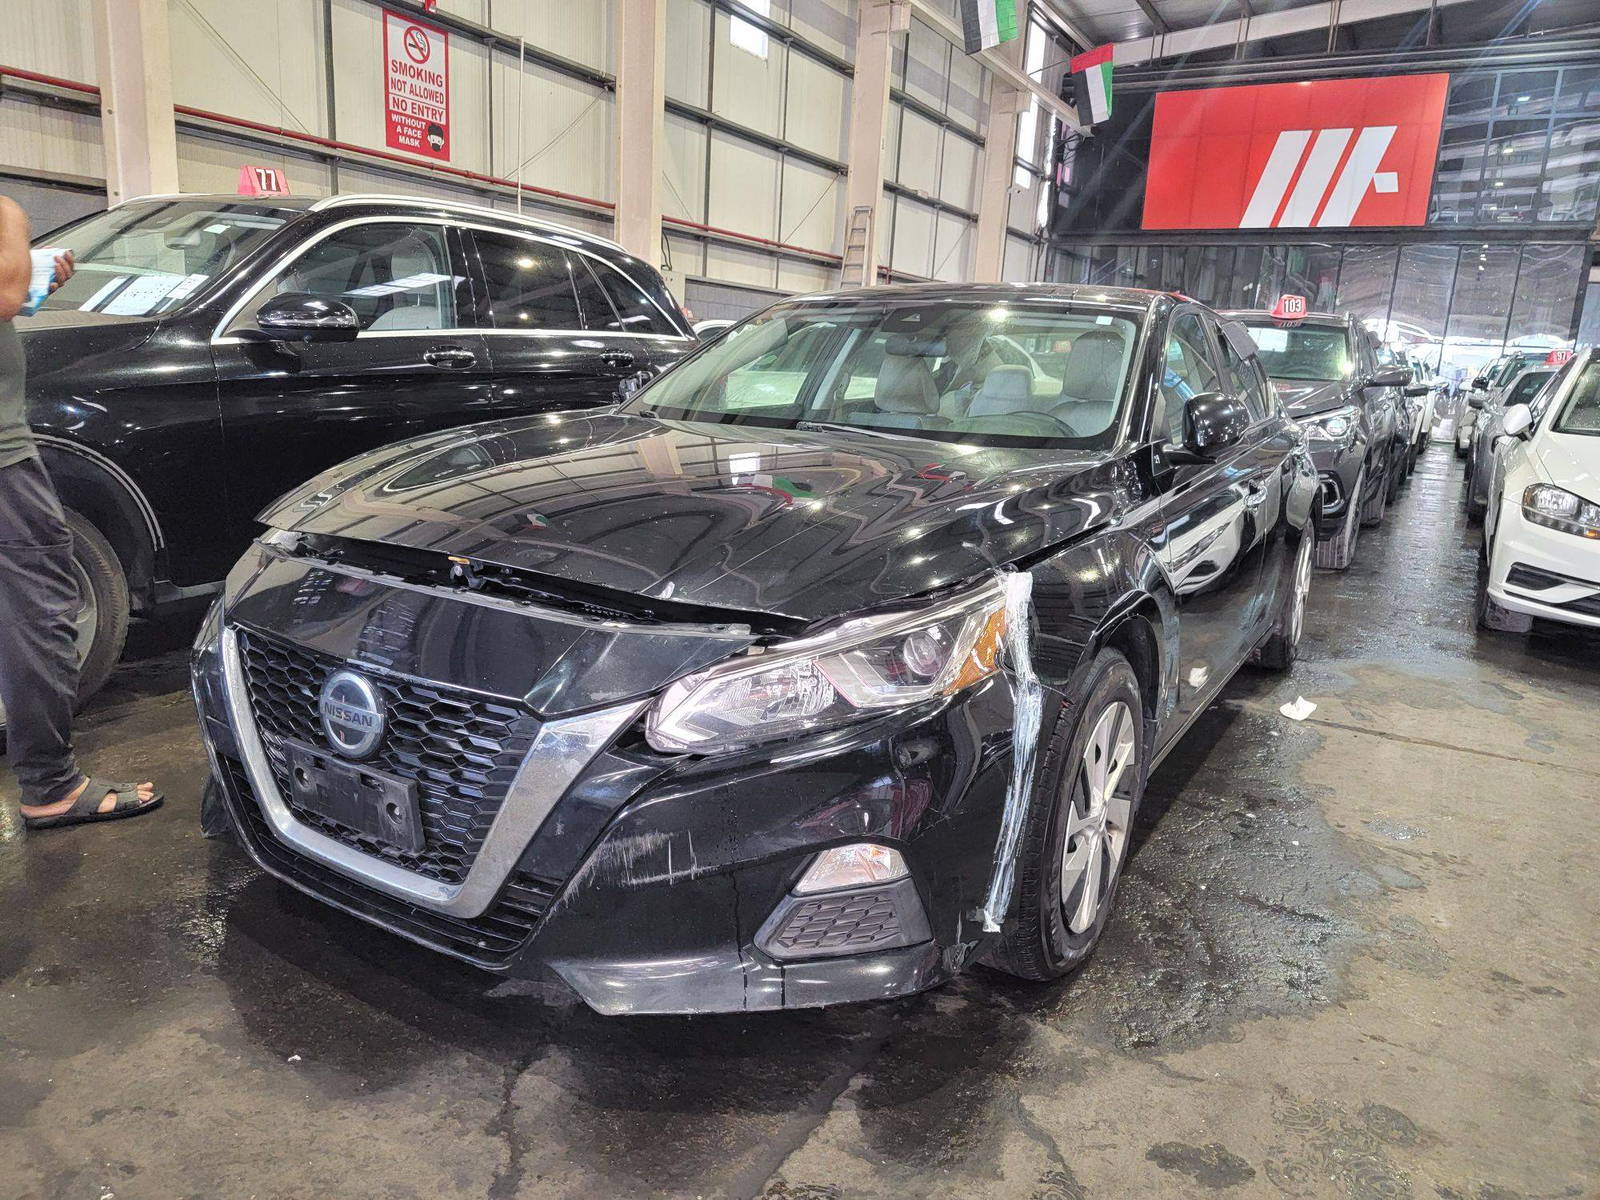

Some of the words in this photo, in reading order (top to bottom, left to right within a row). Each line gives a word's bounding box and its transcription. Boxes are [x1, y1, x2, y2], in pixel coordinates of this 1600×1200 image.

[391, 59, 443, 88] SMOKING
[390, 77, 407, 94] NOT
[409, 83, 445, 105] ALLOWED
[392, 96, 408, 112] NO
[411, 102, 444, 123] ENTRY
[391, 113, 426, 130] WITHOUT
[396, 125, 402, 134] A
[403, 126, 423, 139] FACE
[398, 135, 421, 148] MASK
[254, 168, 277, 191] 77
[1284, 299, 1302, 313] 103
[1557, 351, 1567, 361] 97
[324, 702, 373, 727] NISSAN
